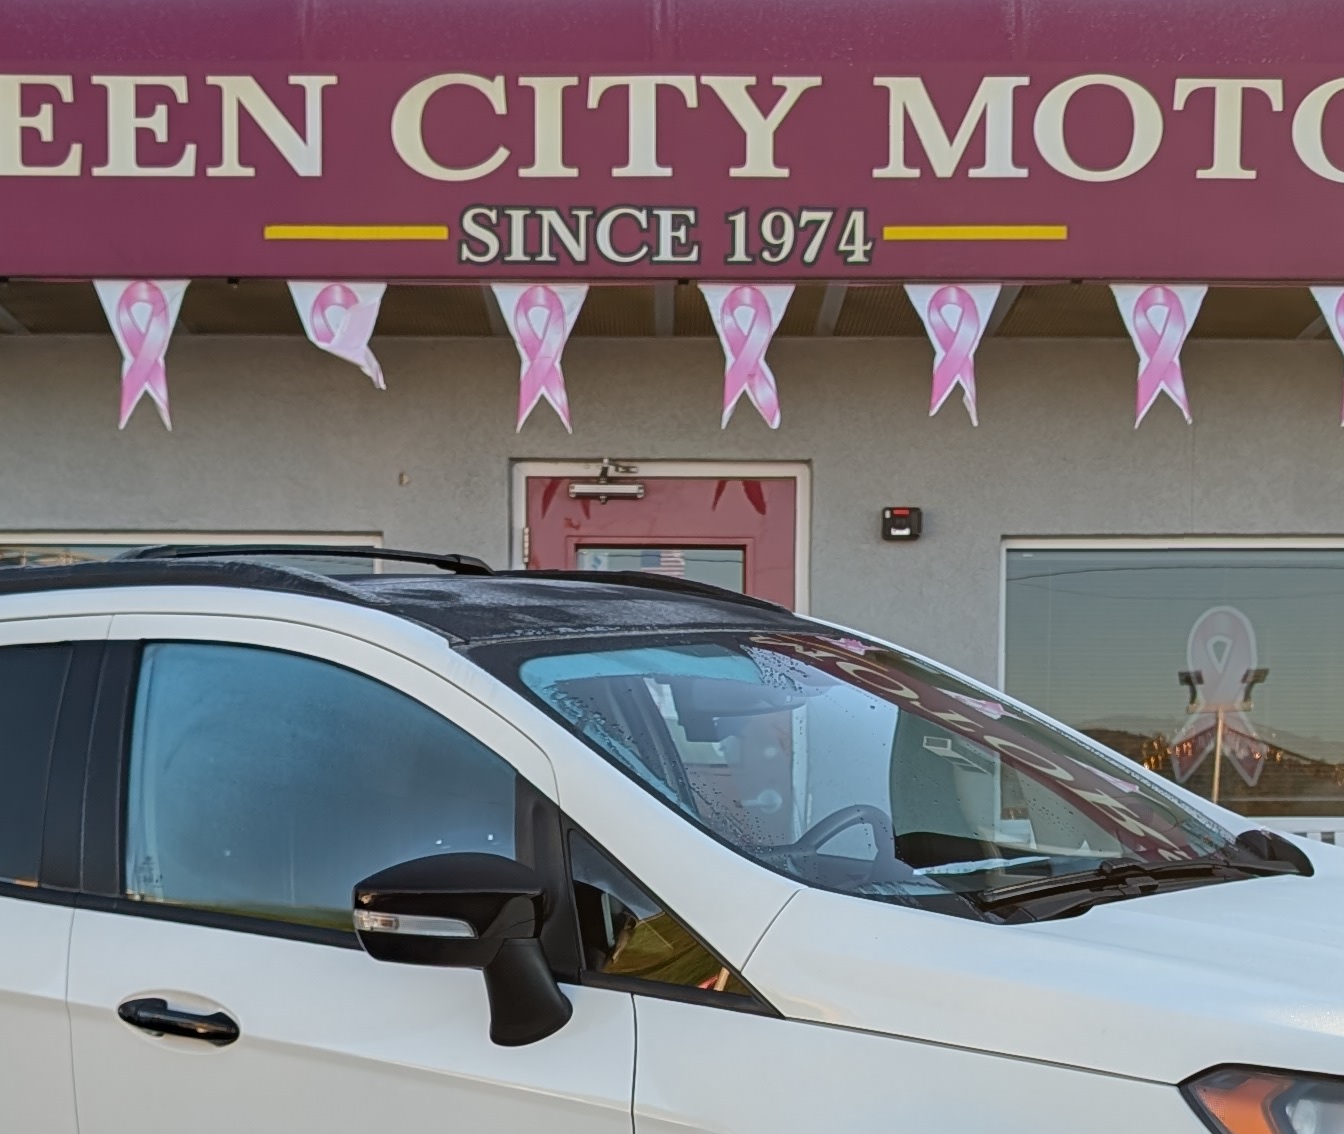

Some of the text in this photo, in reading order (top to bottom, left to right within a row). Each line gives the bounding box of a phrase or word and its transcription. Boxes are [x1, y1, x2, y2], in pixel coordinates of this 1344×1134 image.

[390, 72, 823, 182] CITY
[458, 207, 874, 266] SINCE 1974
